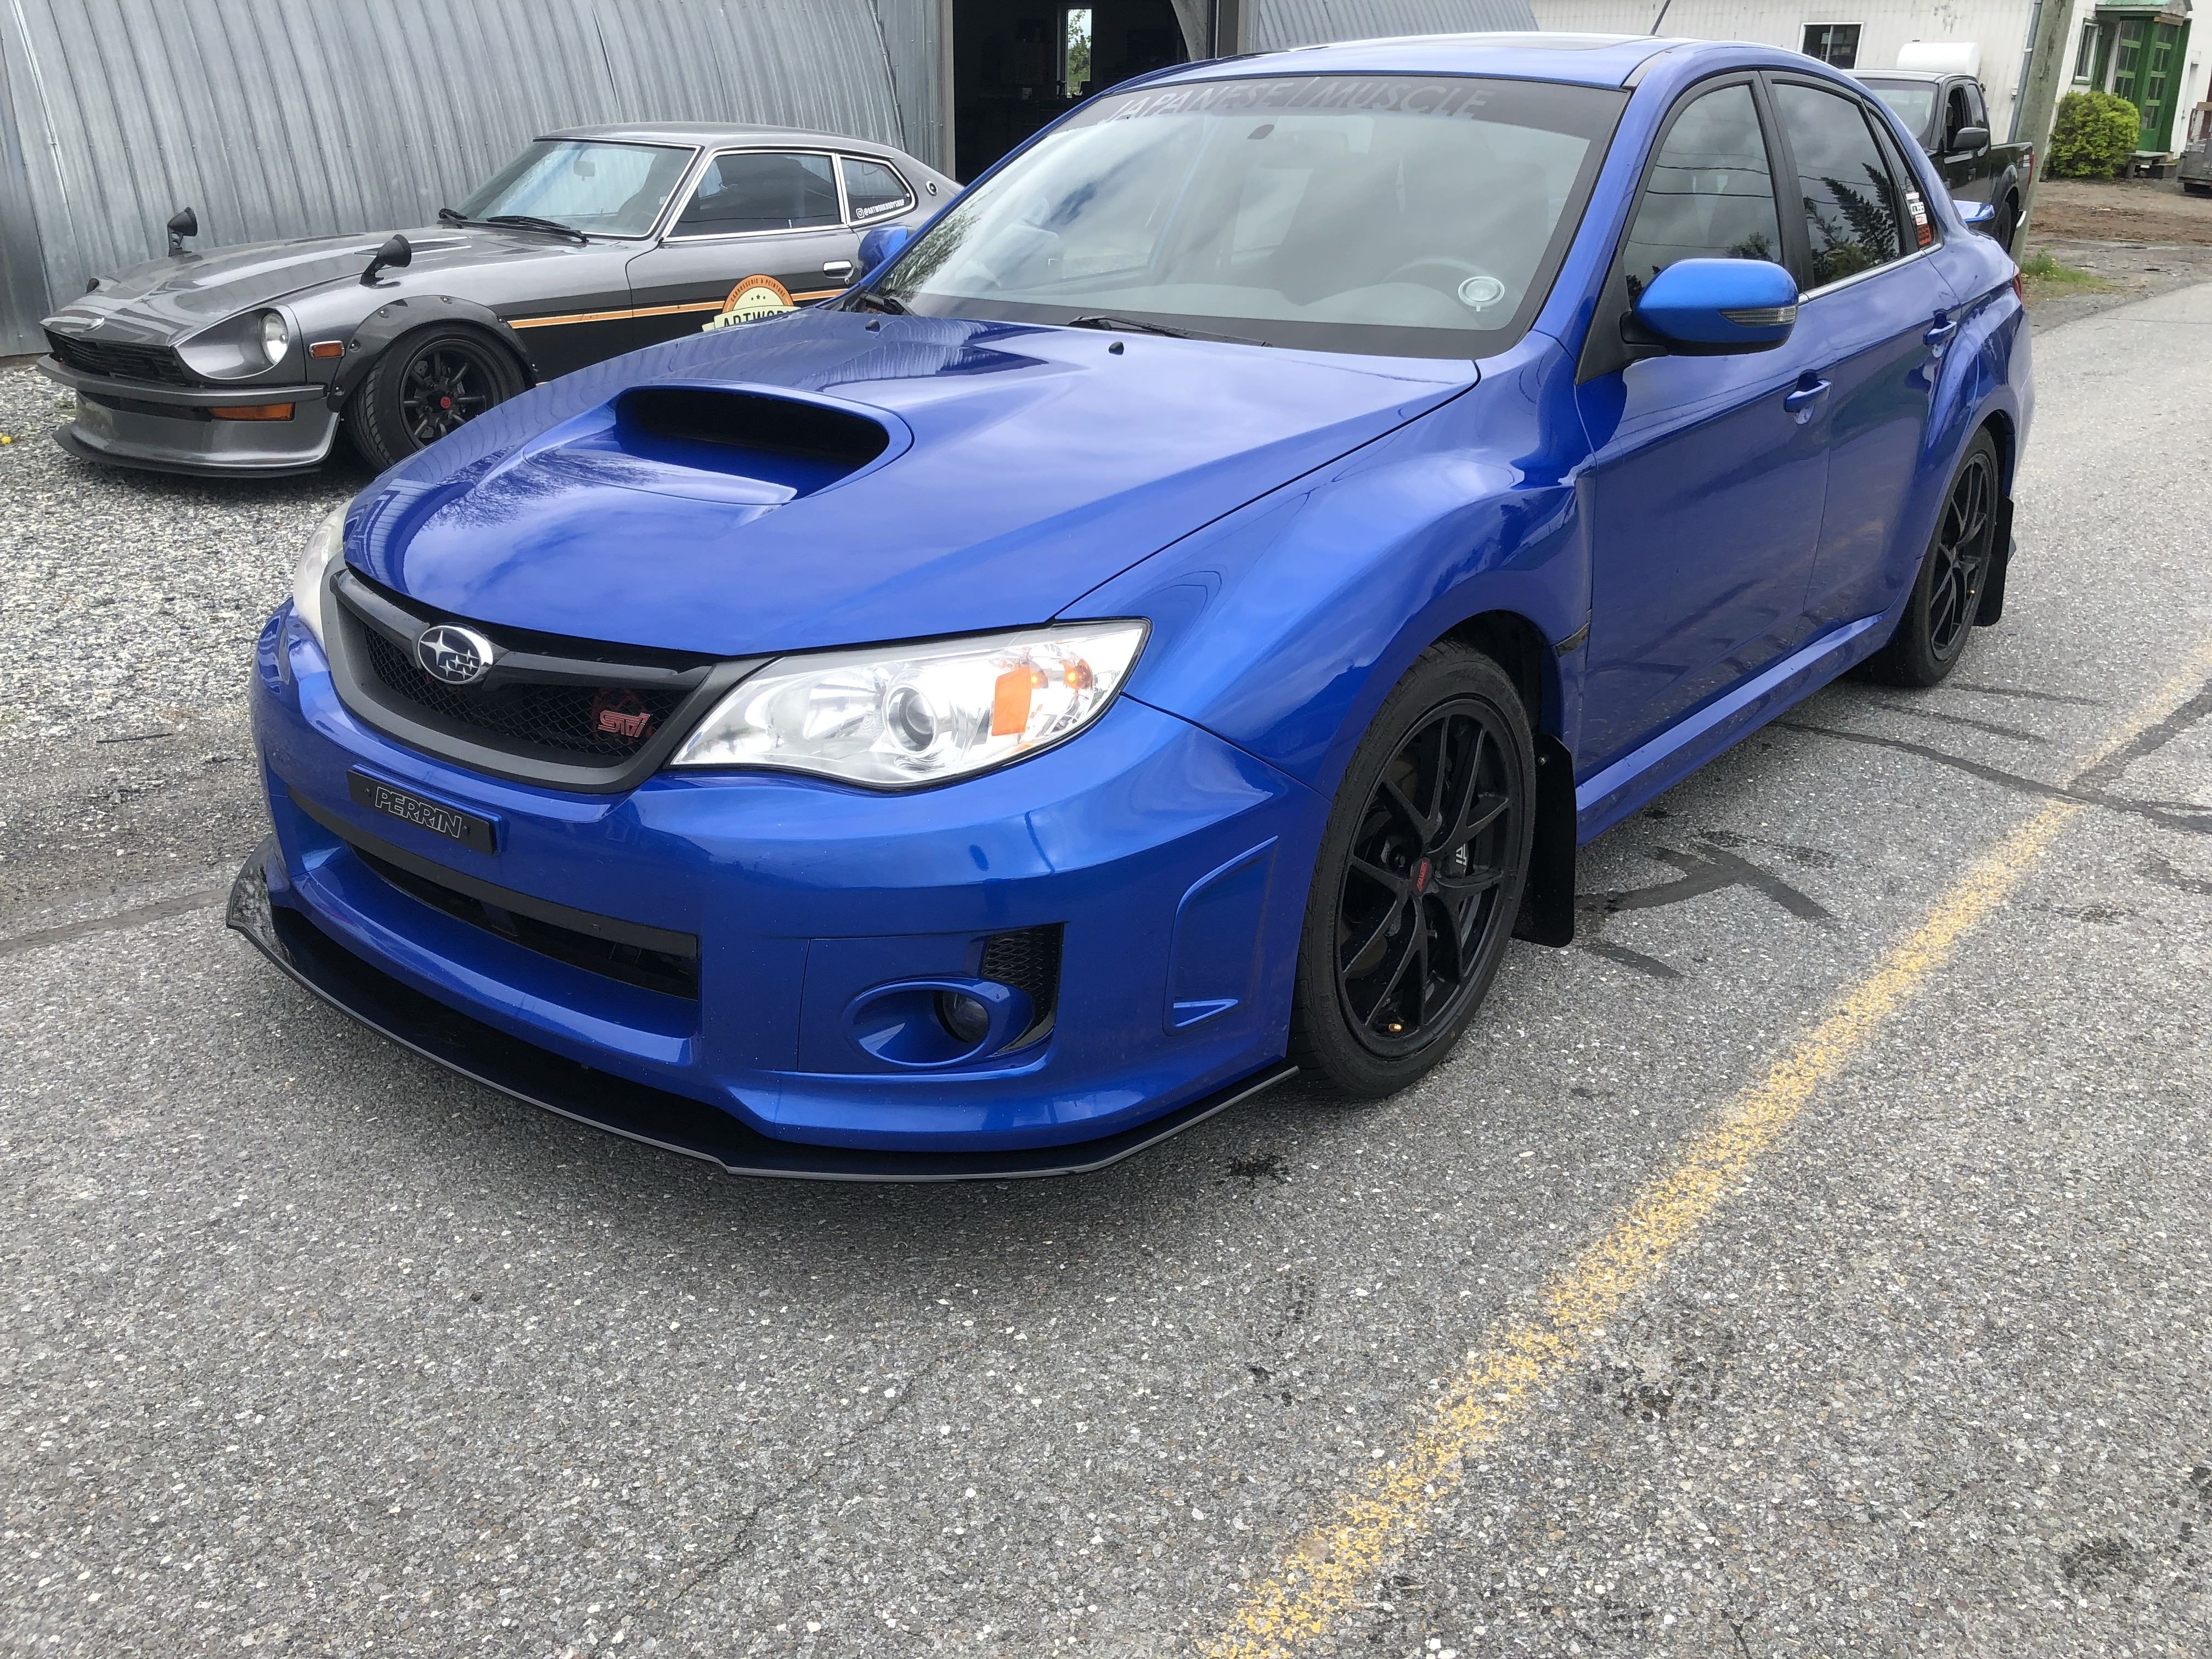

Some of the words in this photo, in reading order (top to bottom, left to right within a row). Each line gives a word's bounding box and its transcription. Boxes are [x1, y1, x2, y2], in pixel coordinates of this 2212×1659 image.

[864, 199, 905, 216] @ARTWORKBODYSHOP
[765, 279, 786, 297] PEINTURE
[375, 786, 462, 838] PERRIN
